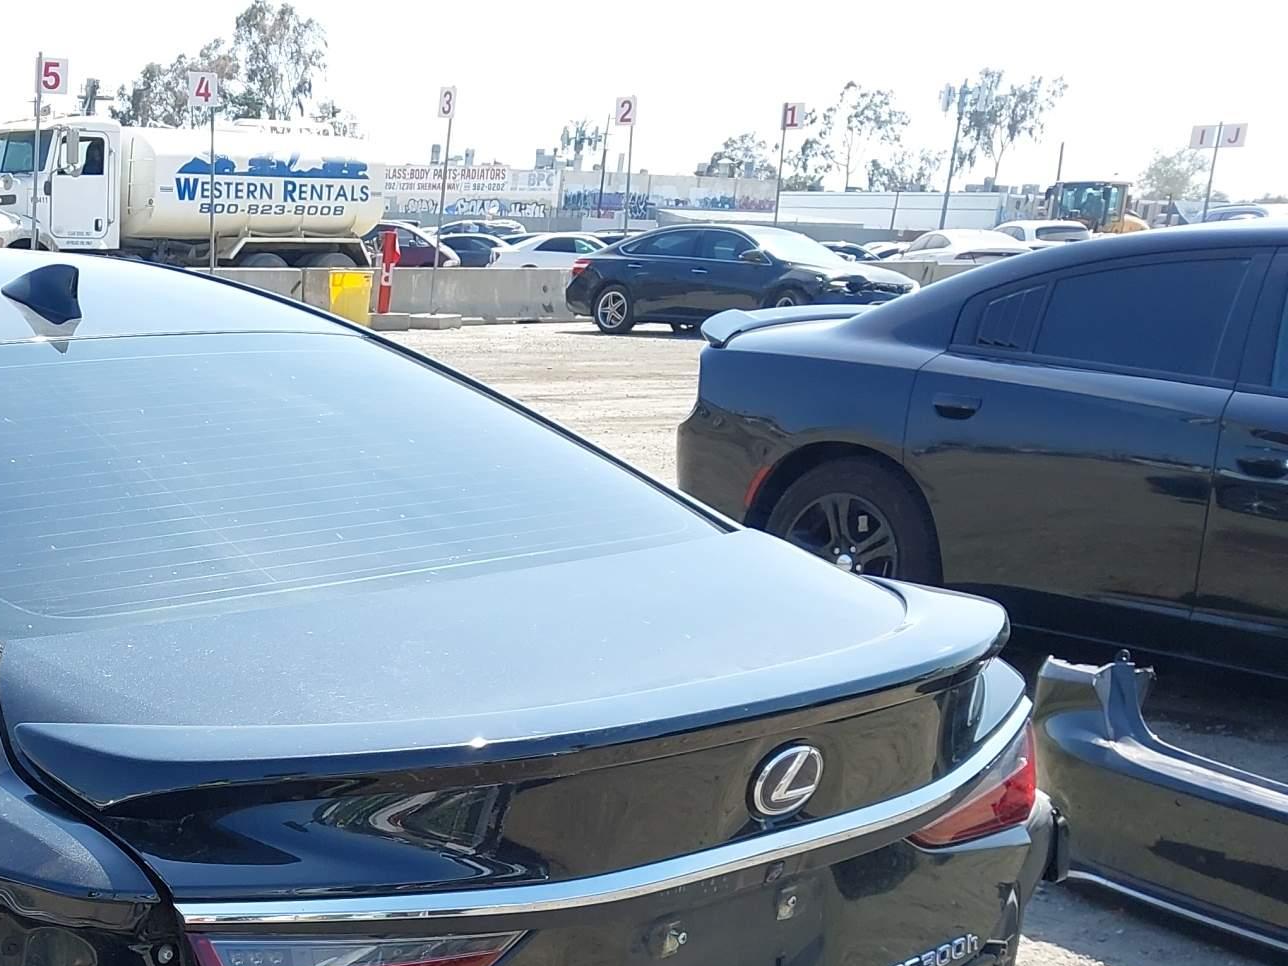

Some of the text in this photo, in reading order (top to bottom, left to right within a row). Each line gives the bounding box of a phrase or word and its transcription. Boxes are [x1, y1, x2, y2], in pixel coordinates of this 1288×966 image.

[42, 61, 60, 90] 5
[195, 76, 211, 102] 4
[441, 90, 453, 115] 3
[619, 100, 632, 122] 2
[786, 105, 798, 127] 1
[1227, 127, 1241, 144] J
[176, 177, 369, 203] WESTERN RENTALS
[199, 203, 345, 216] 800-823-8008
